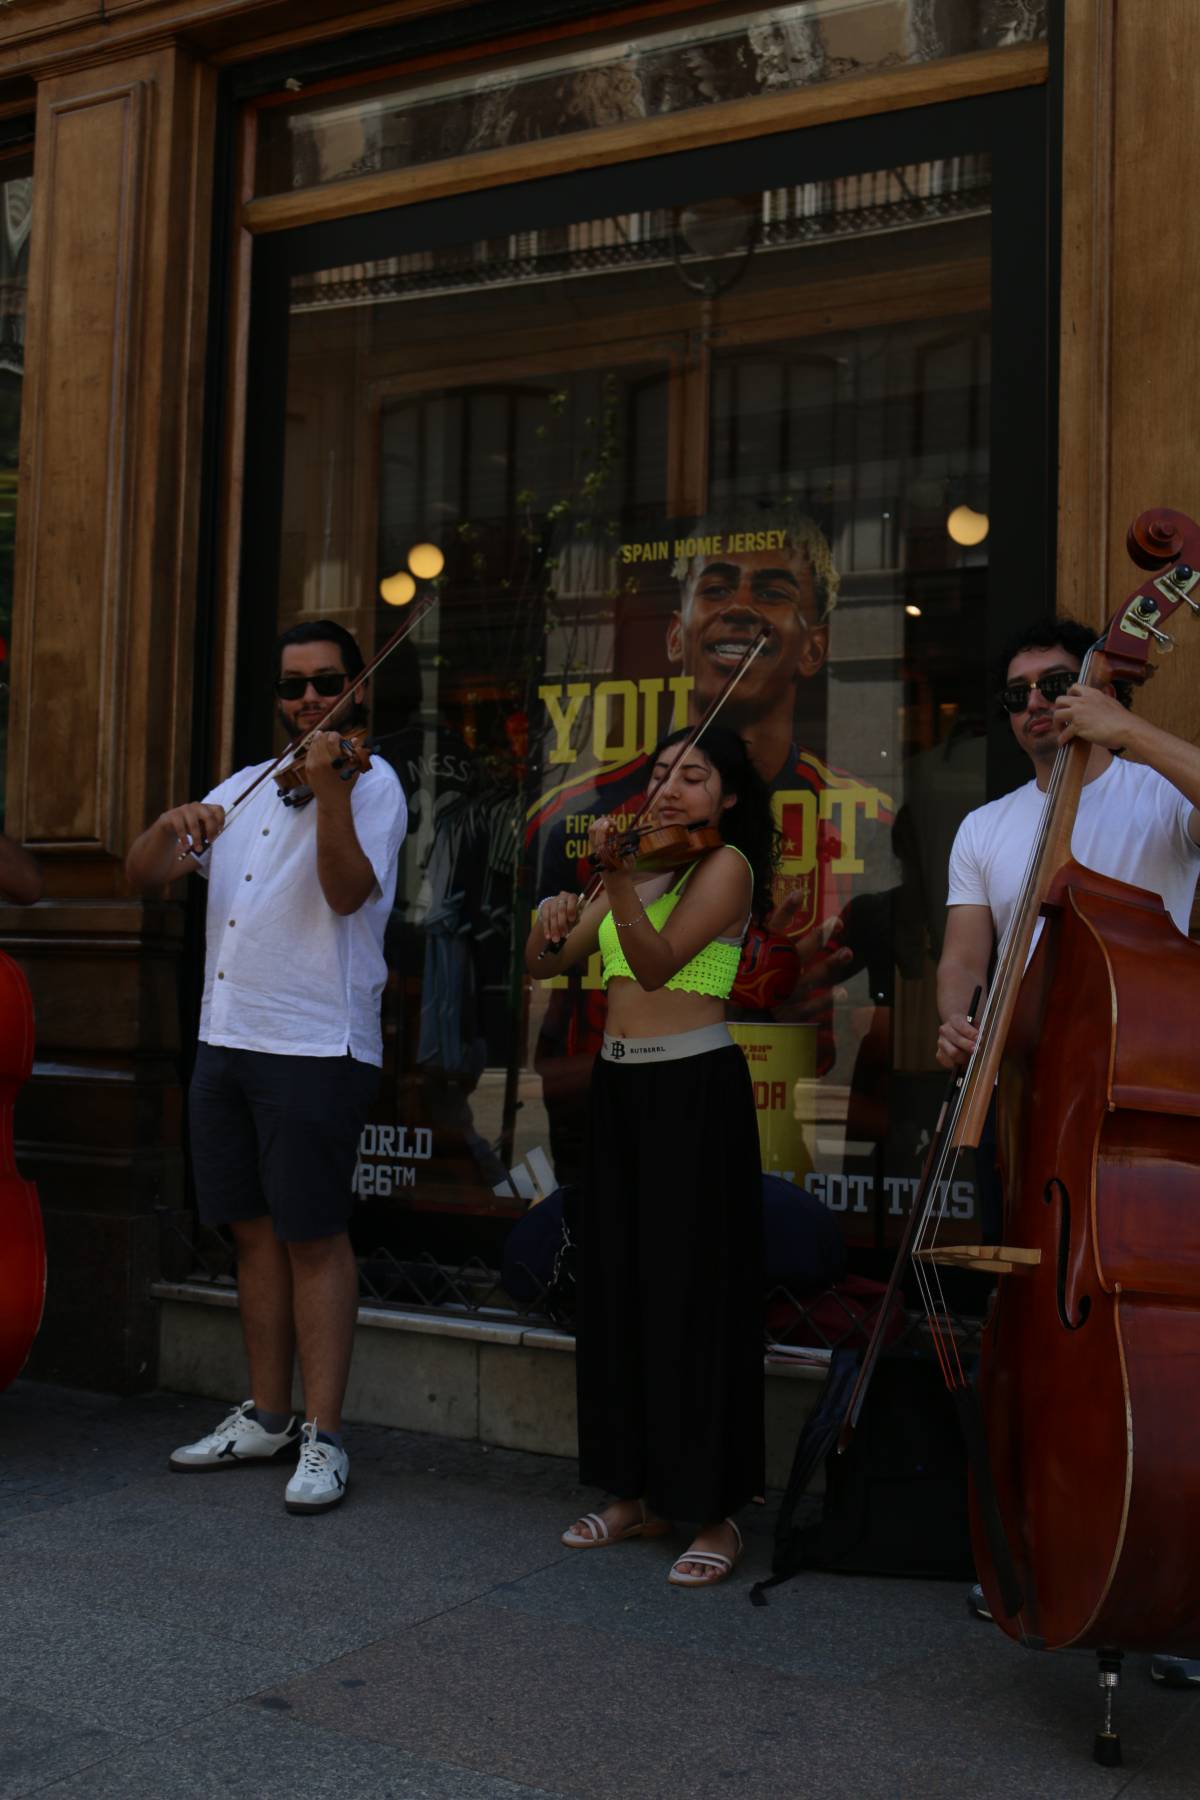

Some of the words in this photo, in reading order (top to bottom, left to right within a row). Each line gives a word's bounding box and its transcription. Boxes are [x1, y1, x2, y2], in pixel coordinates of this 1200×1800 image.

[622, 541, 669, 564] SPAIN
[673, 535, 723, 560] HOME
[727, 528, 788, 554] JERSEY
[769, 786, 878, 876] OT
[360, 1123, 433, 1160] ORLD
